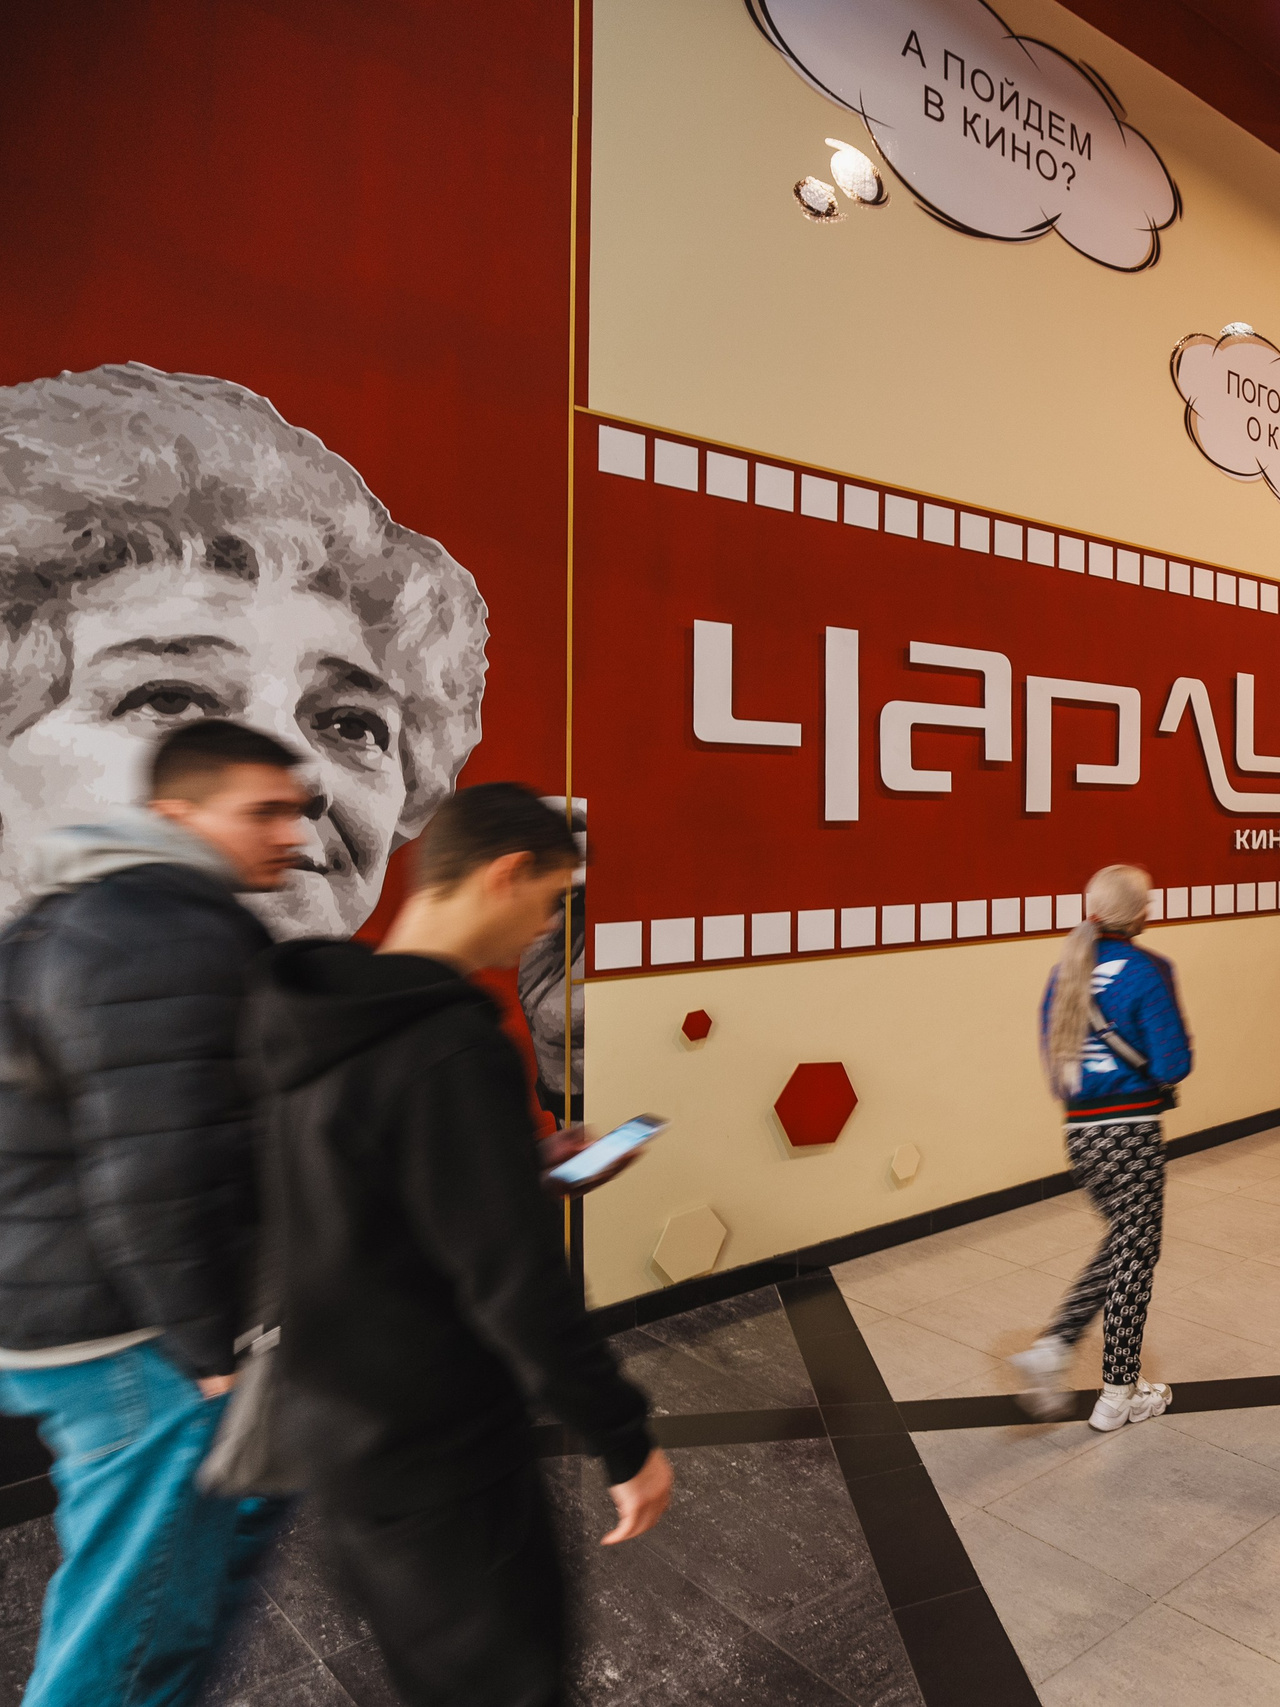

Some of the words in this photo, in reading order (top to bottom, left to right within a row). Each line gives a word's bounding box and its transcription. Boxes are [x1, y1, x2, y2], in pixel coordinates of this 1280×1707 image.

[901, 29, 926, 69] А
[944, 49, 1091, 161] ПОЙДЕМ
[924, 84, 945, 122] В
[963, 106, 1076, 191] КИНО?
[1246, 416, 1261, 442] О
